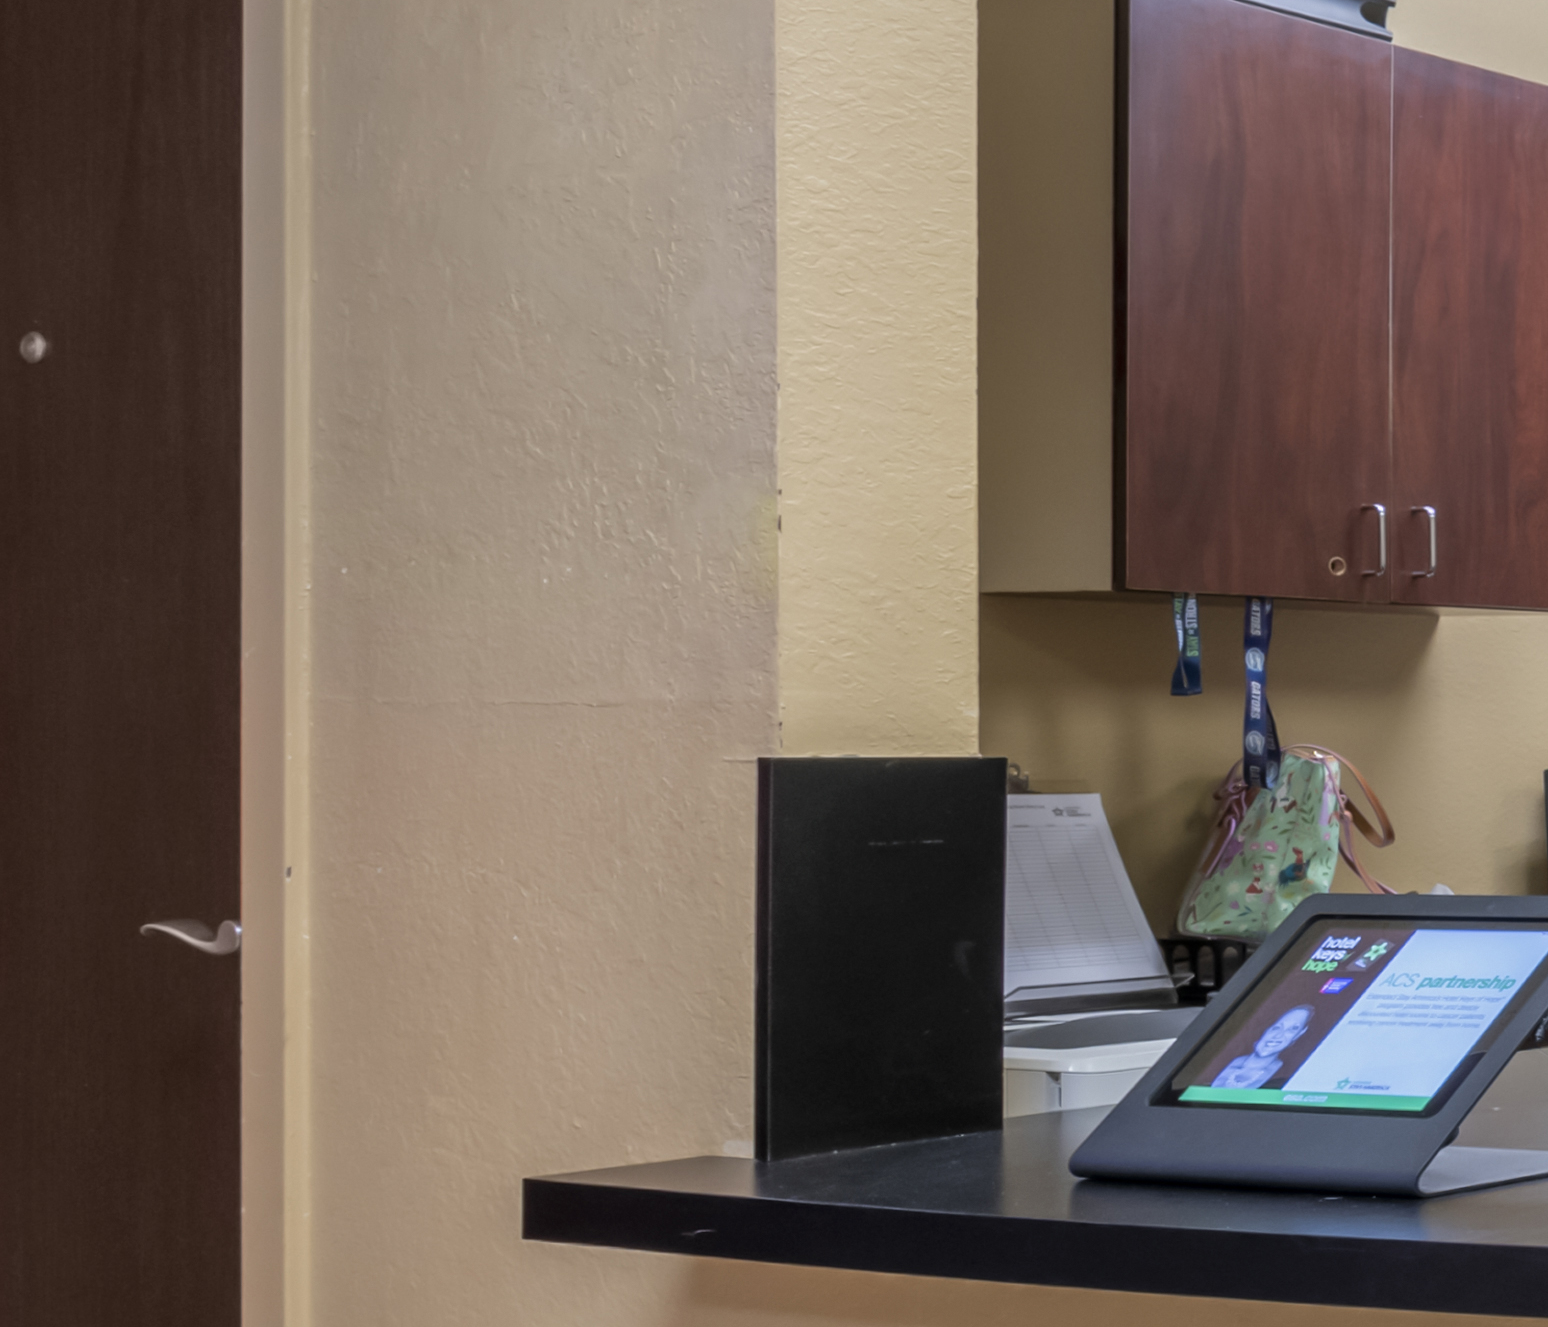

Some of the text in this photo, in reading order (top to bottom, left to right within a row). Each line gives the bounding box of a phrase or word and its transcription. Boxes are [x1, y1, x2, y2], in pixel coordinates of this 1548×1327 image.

[1250, 680, 1262, 720] GATORS
[1321, 935, 1362, 949] hotel
[1311, 947, 1347, 962] keys
[1301, 958, 1339, 973] hope
[1378, 973, 1517, 993] ACS partnership
